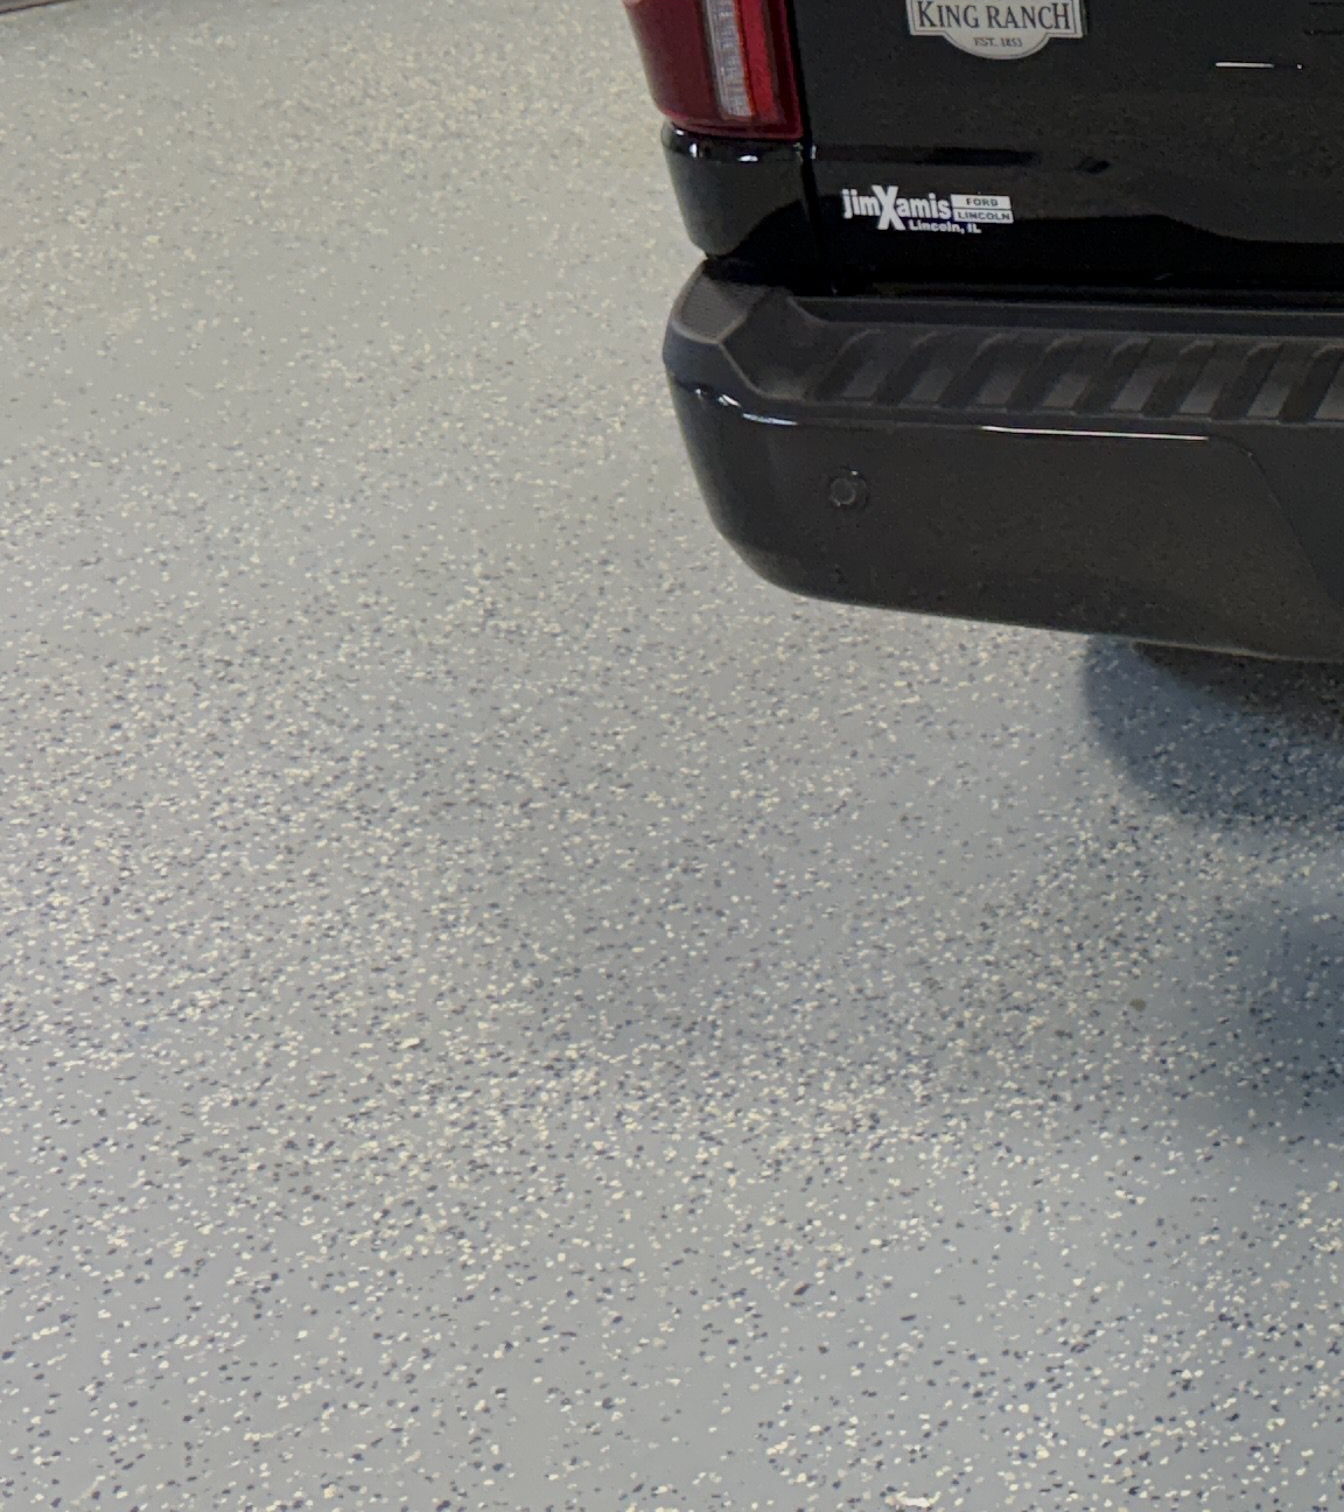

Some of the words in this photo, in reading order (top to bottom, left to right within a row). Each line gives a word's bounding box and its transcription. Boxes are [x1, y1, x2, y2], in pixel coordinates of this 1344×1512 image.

[917, 0, 979, 29] KING
[986, 2, 1070, 30] RANCH
[966, 198, 999, 207] FORD
[957, 211, 1011, 221] LINCOLN
[908, 219, 965, 234] Lincoln,
[967, 223, 982, 234] IL
